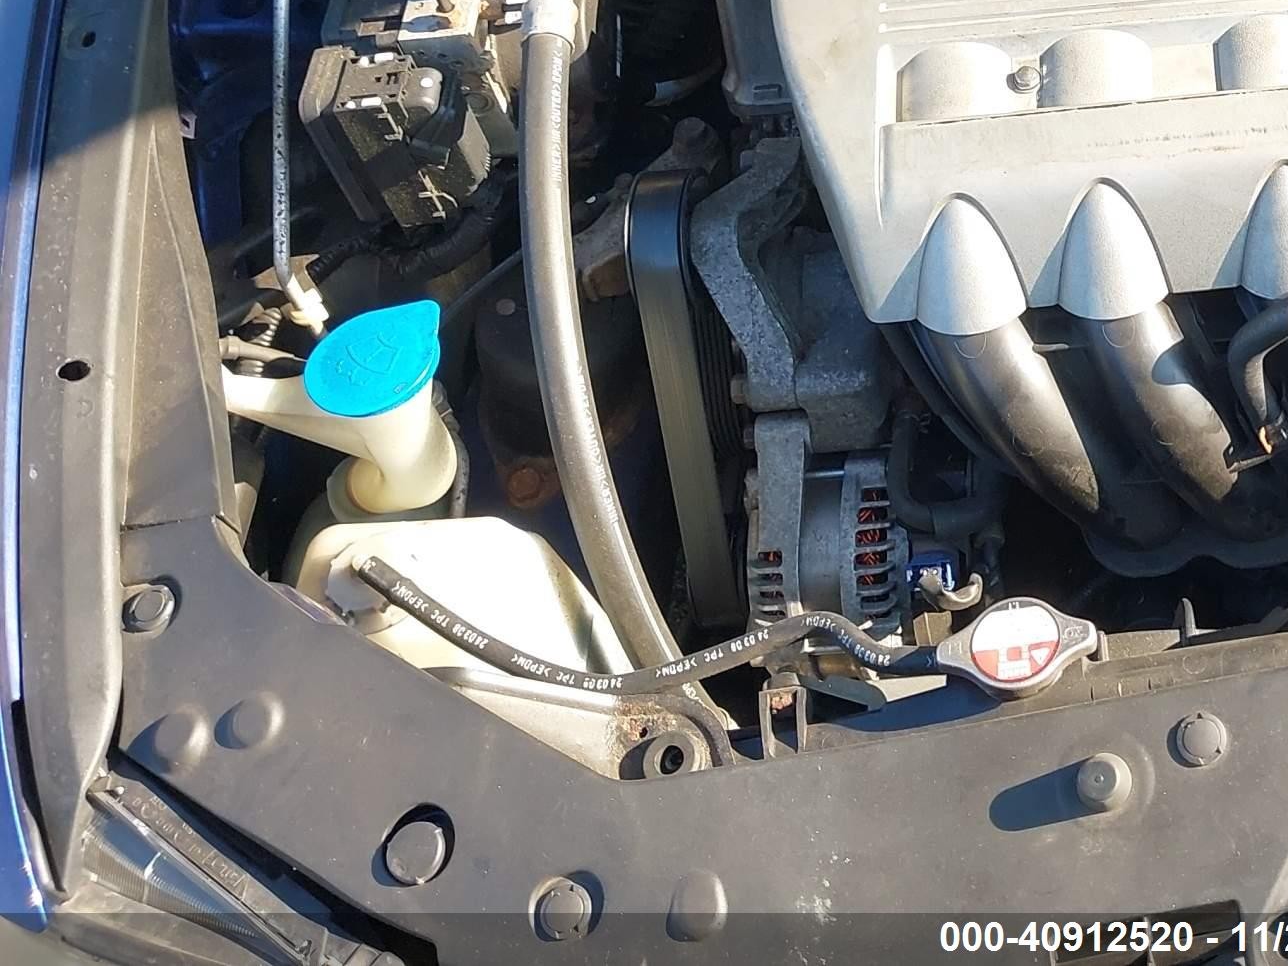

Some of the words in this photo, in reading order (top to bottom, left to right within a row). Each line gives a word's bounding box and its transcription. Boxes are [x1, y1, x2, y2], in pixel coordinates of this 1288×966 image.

[430, 609, 450, 627] TPC
[703, 647, 724, 663] TPC
[555, 671, 576, 685] TPC
